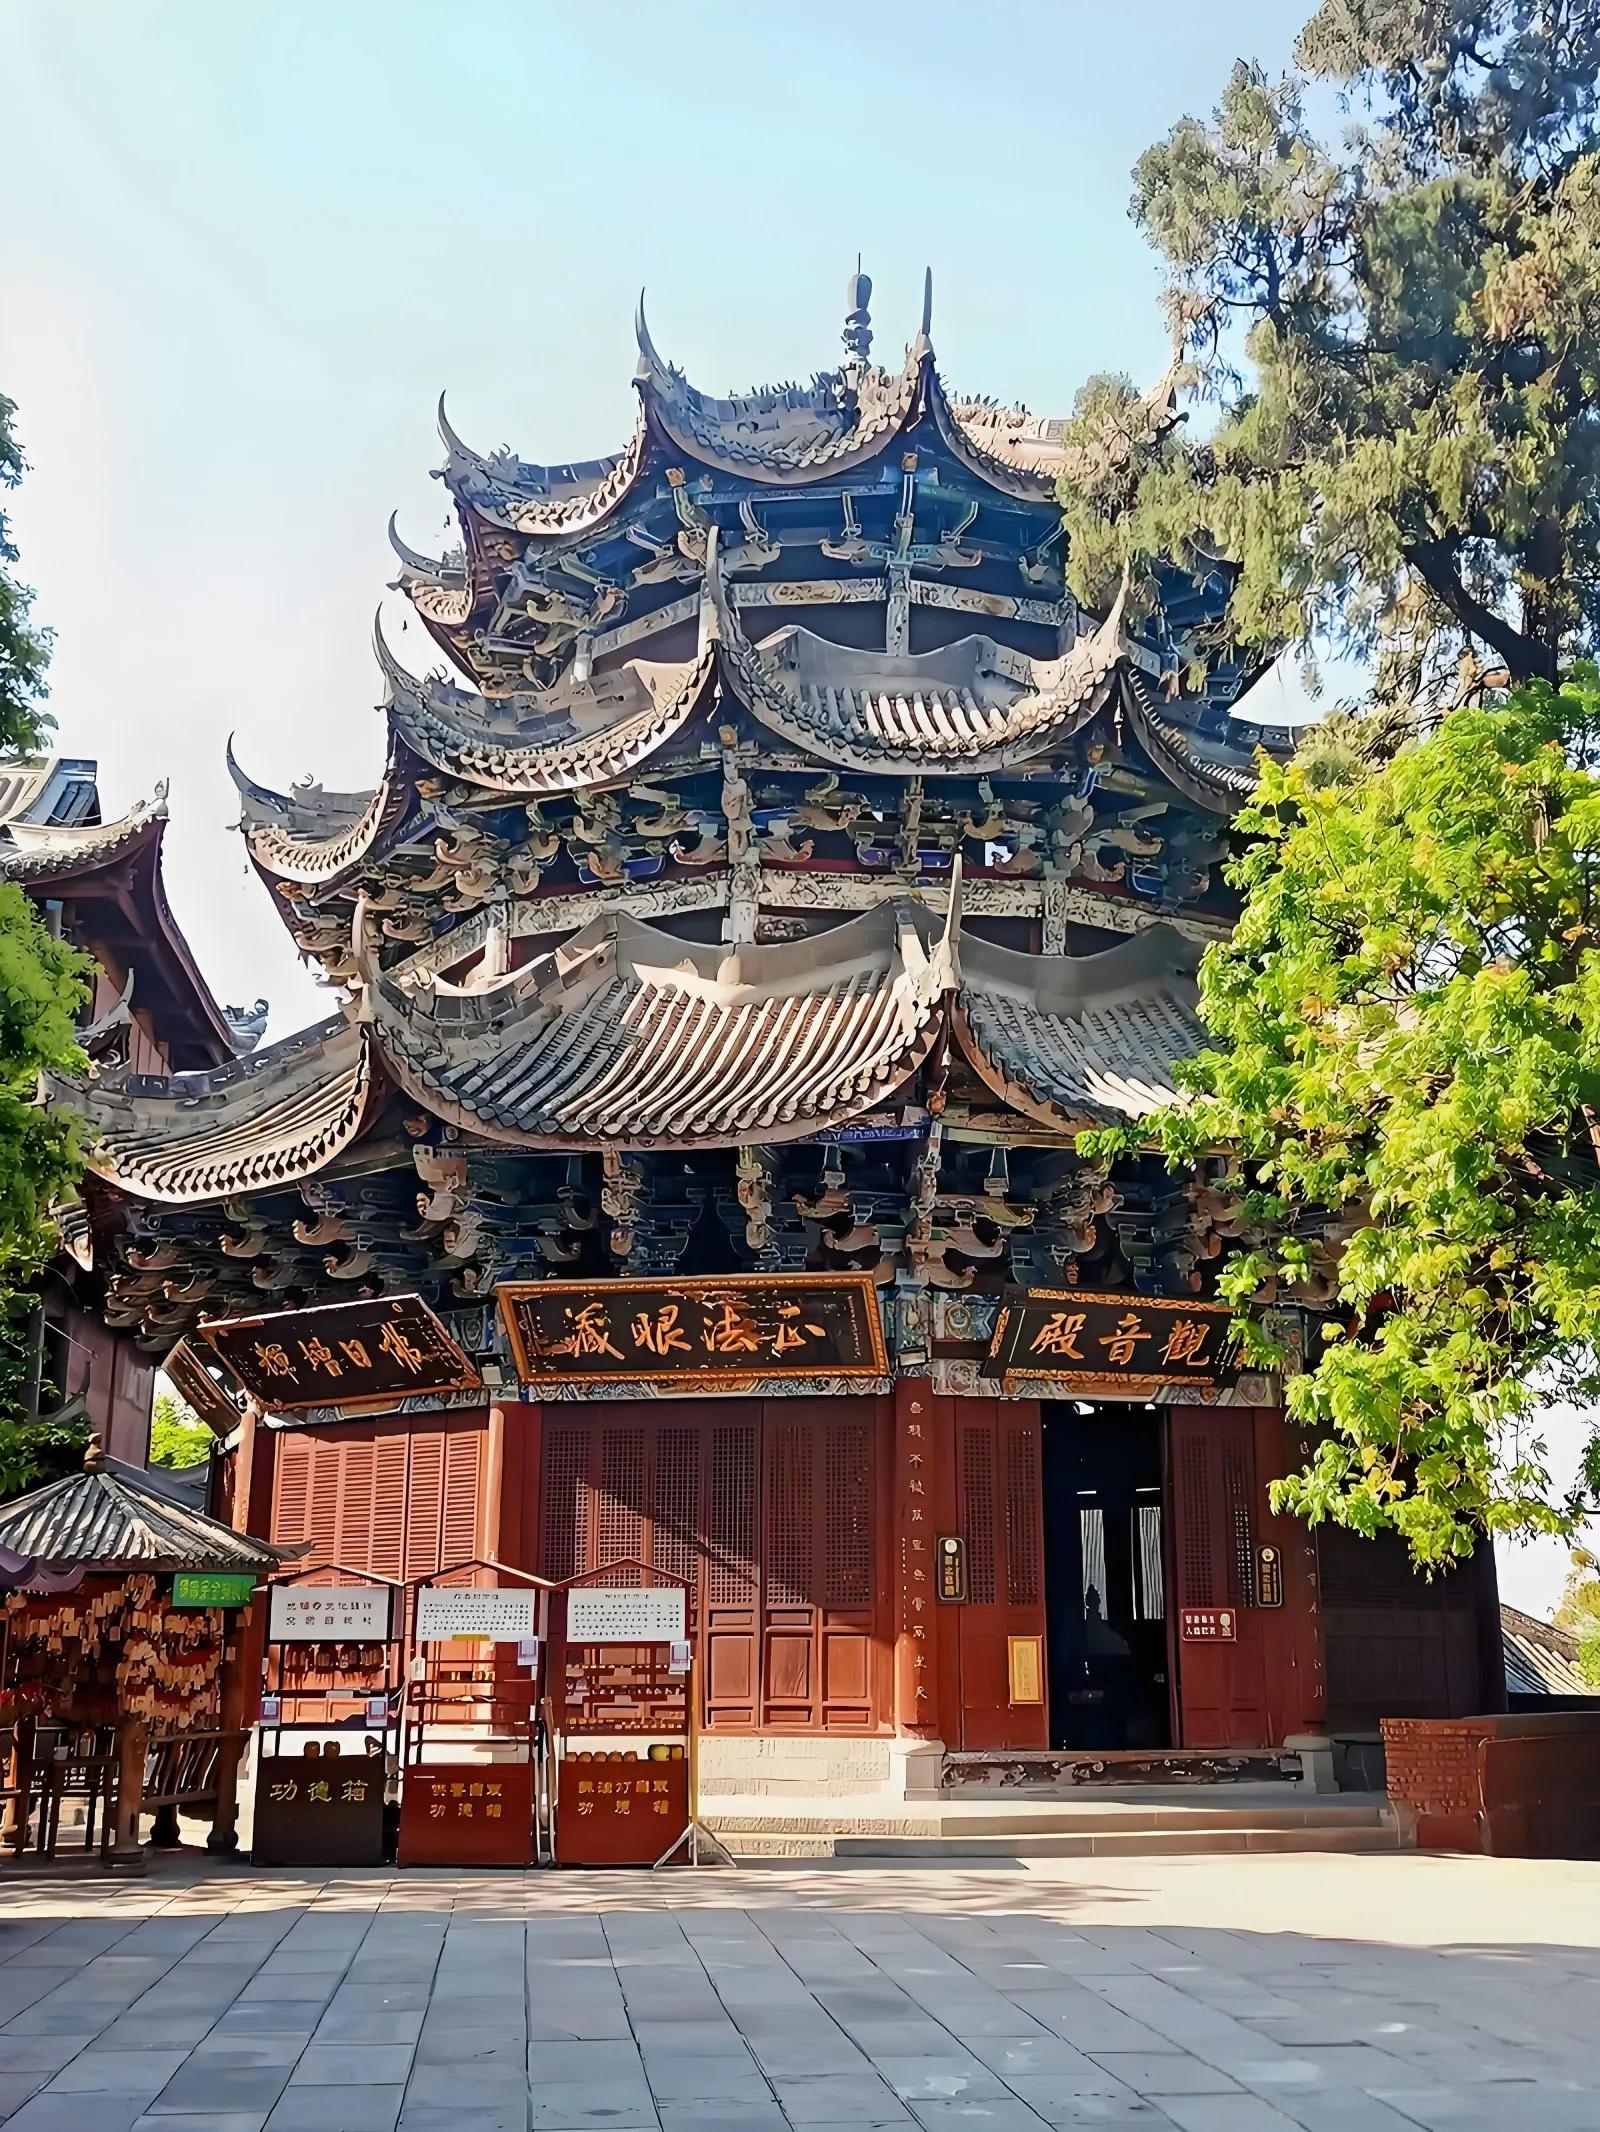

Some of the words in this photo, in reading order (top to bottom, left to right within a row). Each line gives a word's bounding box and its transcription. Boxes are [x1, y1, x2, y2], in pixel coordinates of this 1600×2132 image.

[1030, 1313, 1210, 1366] 觀音殿
[270, 1779, 369, 1802] 功德箱
